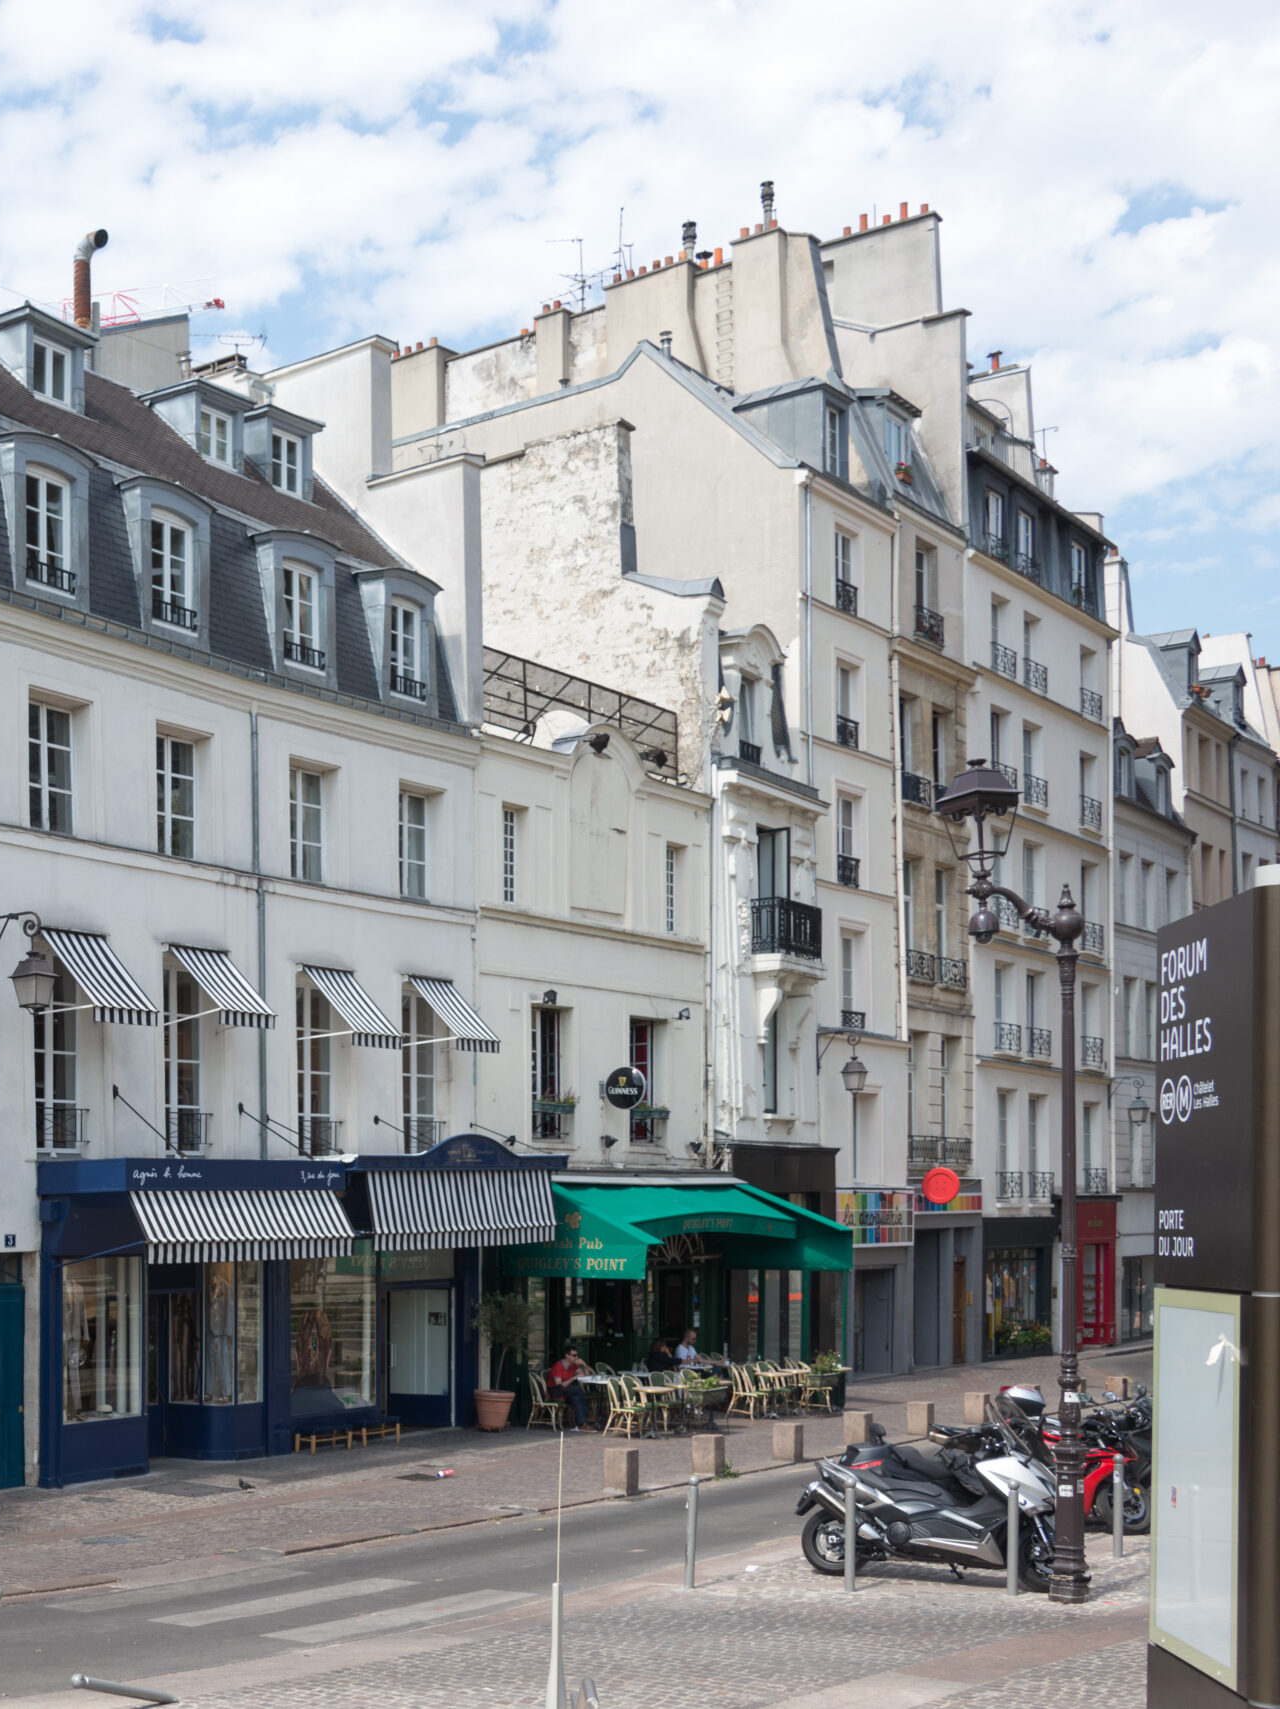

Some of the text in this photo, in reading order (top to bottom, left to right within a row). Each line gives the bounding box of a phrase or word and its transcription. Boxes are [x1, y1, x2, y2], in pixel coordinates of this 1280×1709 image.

[1161, 937, 1207, 986] FORUM
[1161, 985, 1186, 1024] DES
[1161, 1017, 1212, 1062] HALLES
[608, 1086, 638, 1095] GUINNESS
[1159, 1209, 1185, 1230] PORTE
[578, 1237, 603, 1250] Pub
[1159, 1236, 1194, 1257] DU JOUR
[586, 1258, 628, 1271] POINT
